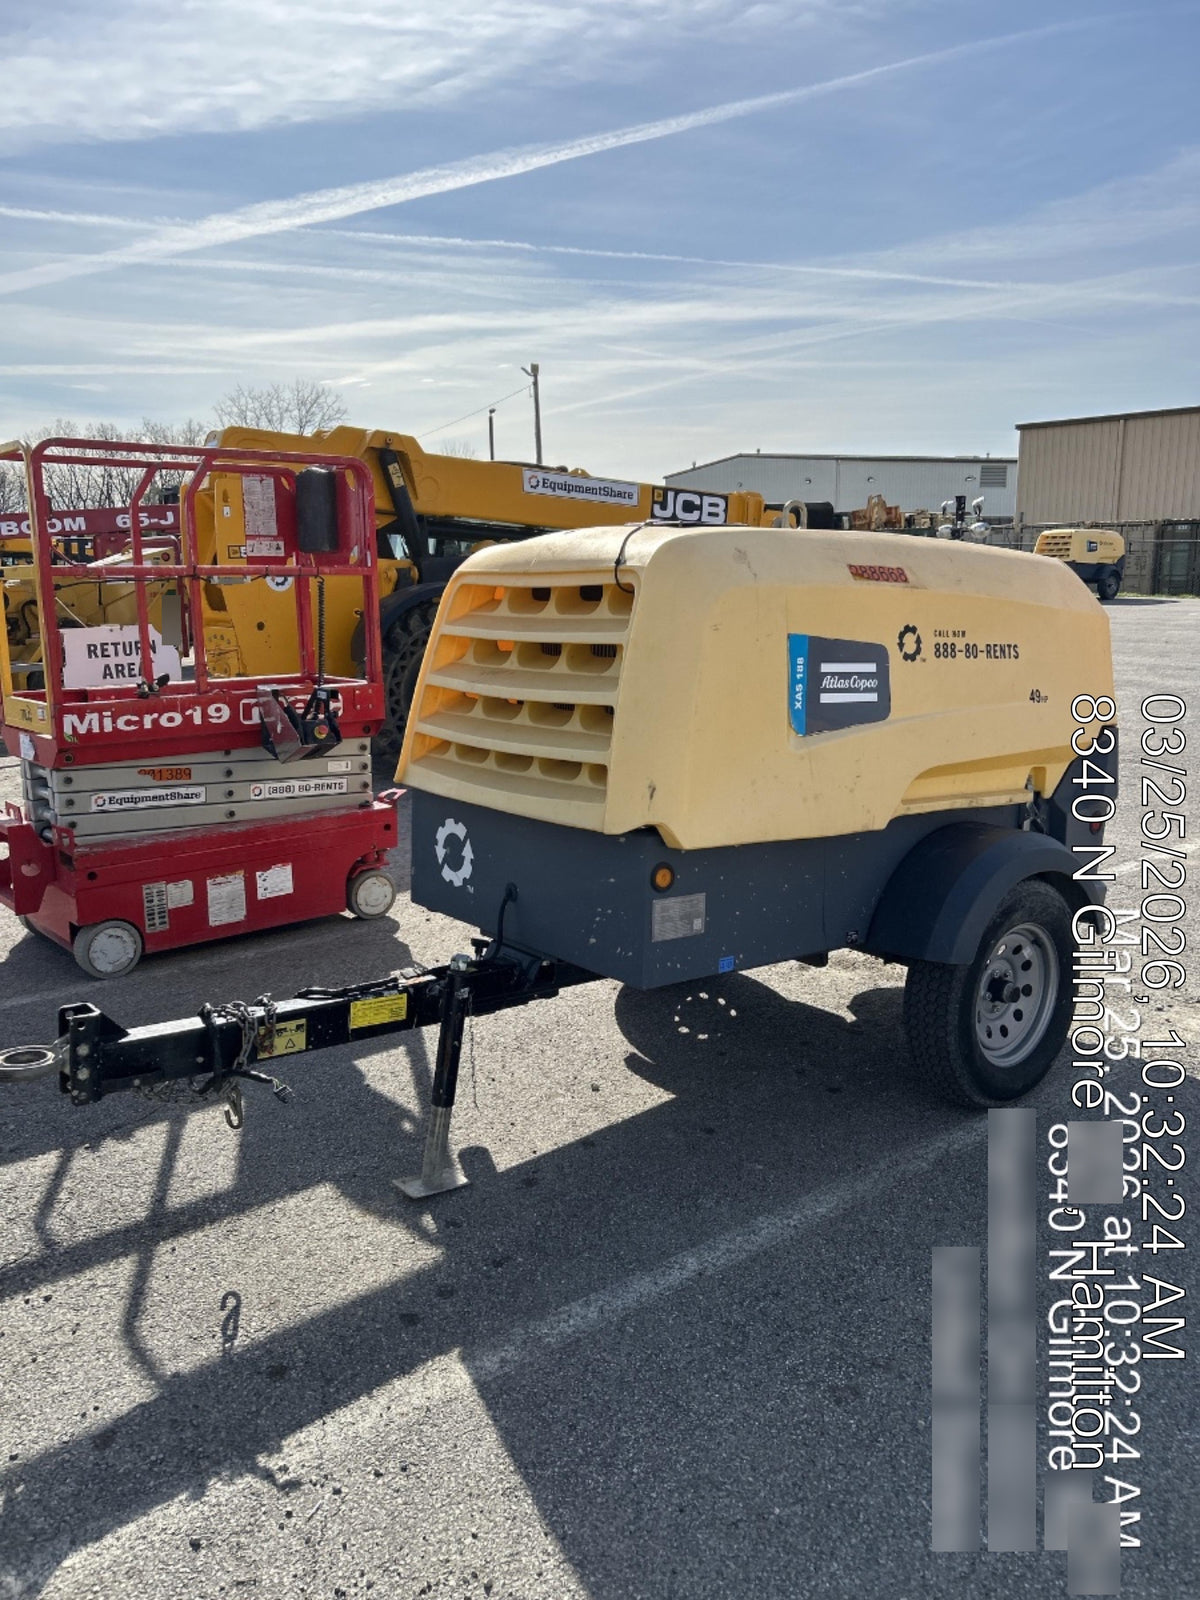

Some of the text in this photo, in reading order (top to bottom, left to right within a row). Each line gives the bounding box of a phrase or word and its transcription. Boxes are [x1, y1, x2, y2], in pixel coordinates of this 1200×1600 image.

[541, 478, 634, 500] EquipmentShare
[653, 492, 727, 524] JCB
[934, 629, 950, 638] CALL
[934, 642, 1019, 660] 888-80-RENTS
[795, 657, 805, 710] XAS 188
[63, 703, 231, 736] Micro19
[108, 791, 201, 808] EquipmentShare
[268, 785, 296, 795] (888)
